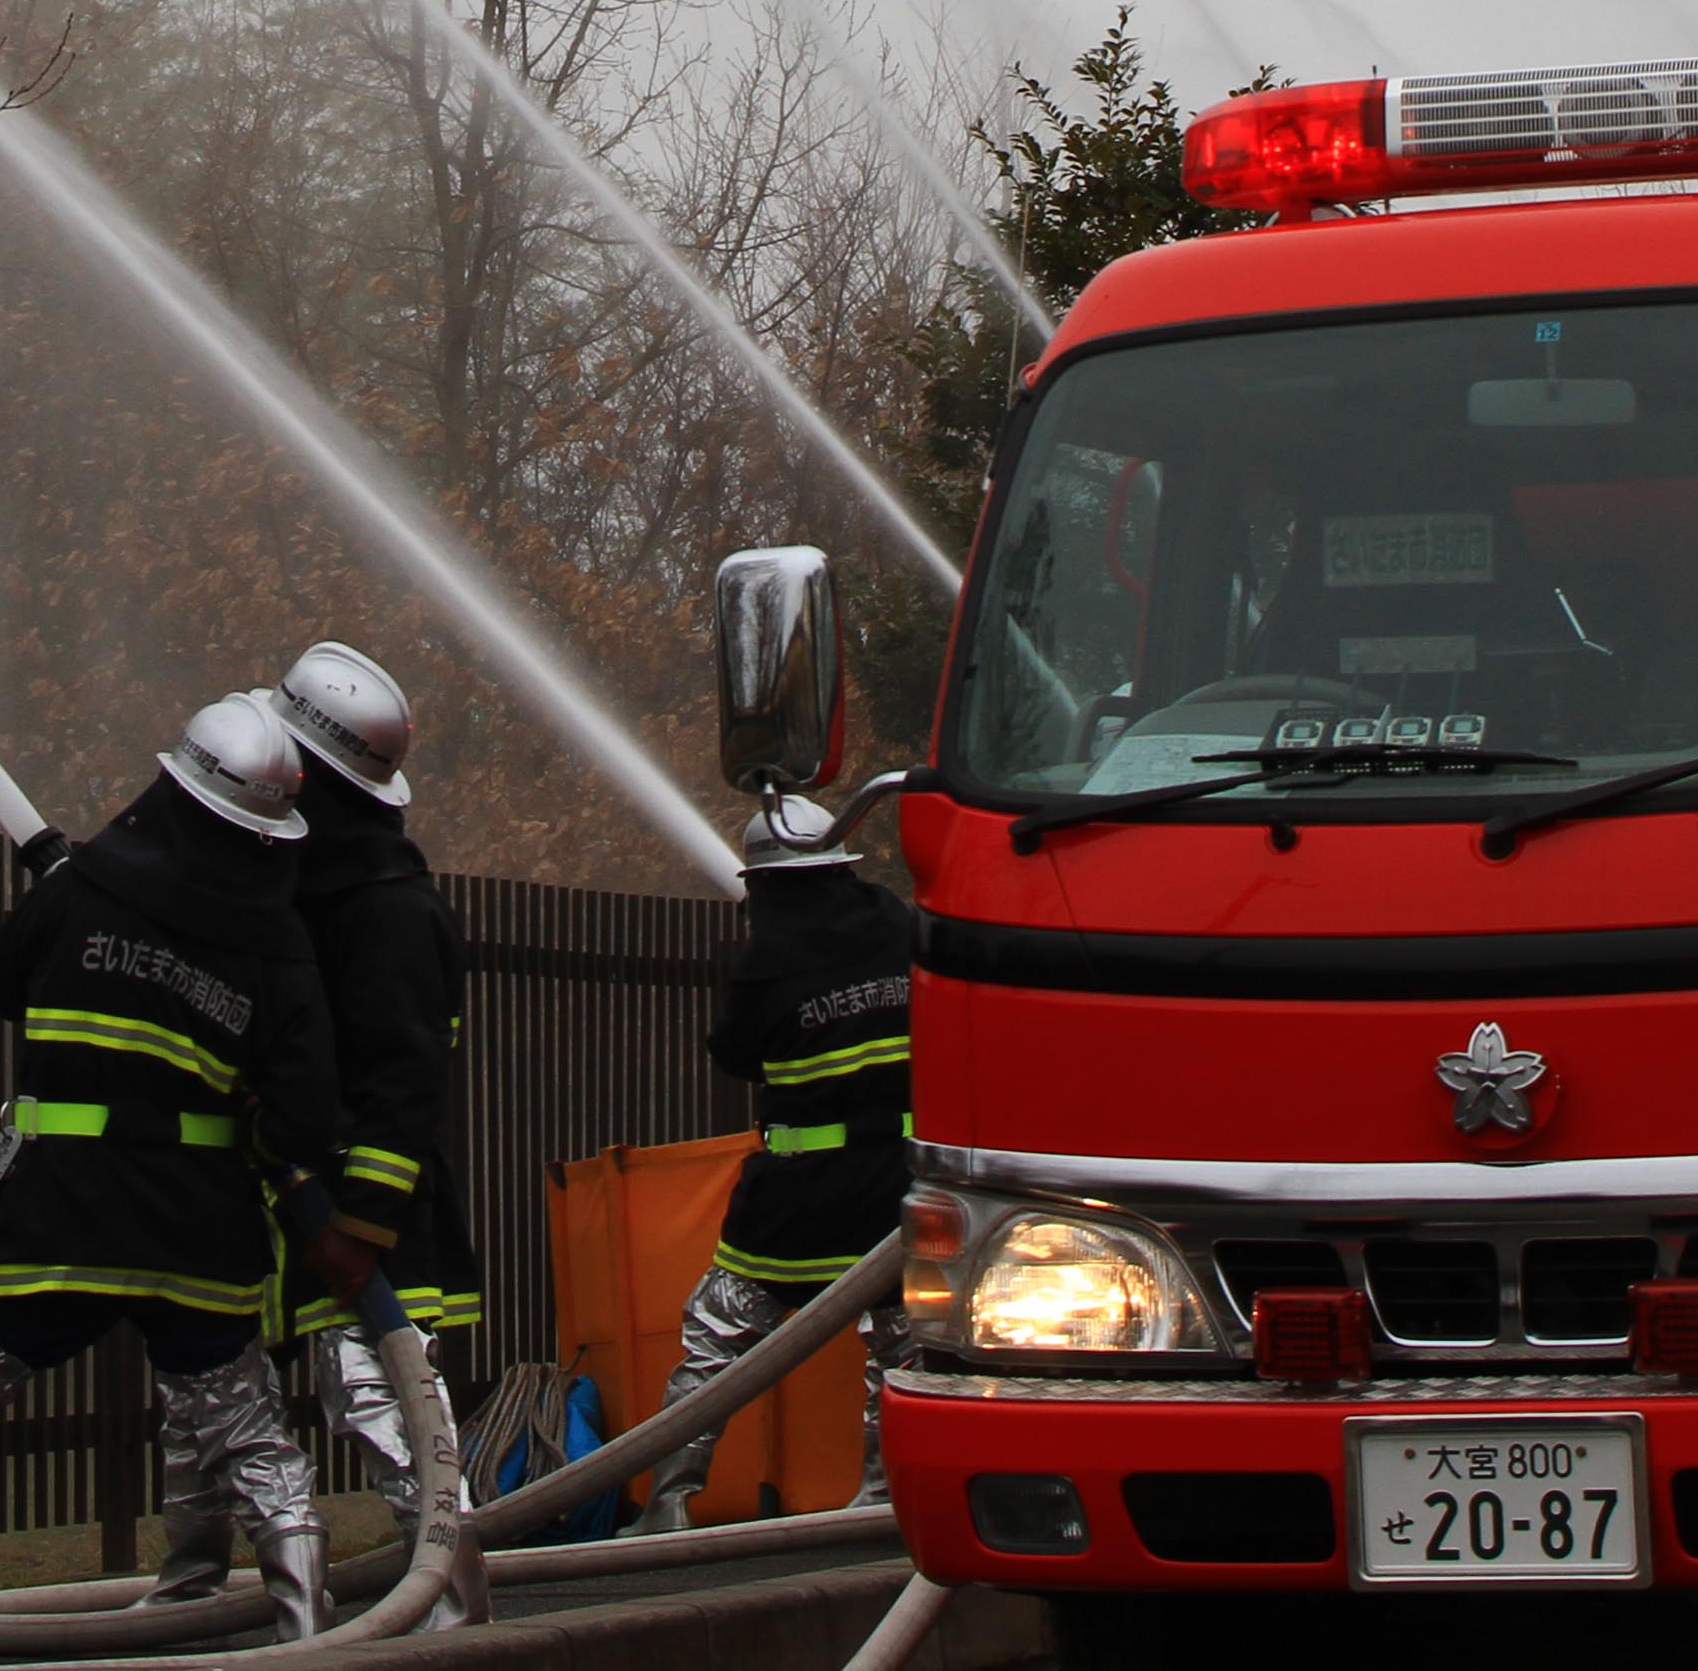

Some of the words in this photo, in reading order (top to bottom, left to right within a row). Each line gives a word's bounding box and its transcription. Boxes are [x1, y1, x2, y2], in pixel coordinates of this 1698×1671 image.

[82, 931, 252, 1035] さいたま市消防団
[1427, 1444, 1499, 1481] 大宮
[1508, 1442, 1572, 1480] 800
[1380, 1511, 1414, 1545] せ
[1423, 1487, 1618, 1561] 20-87
